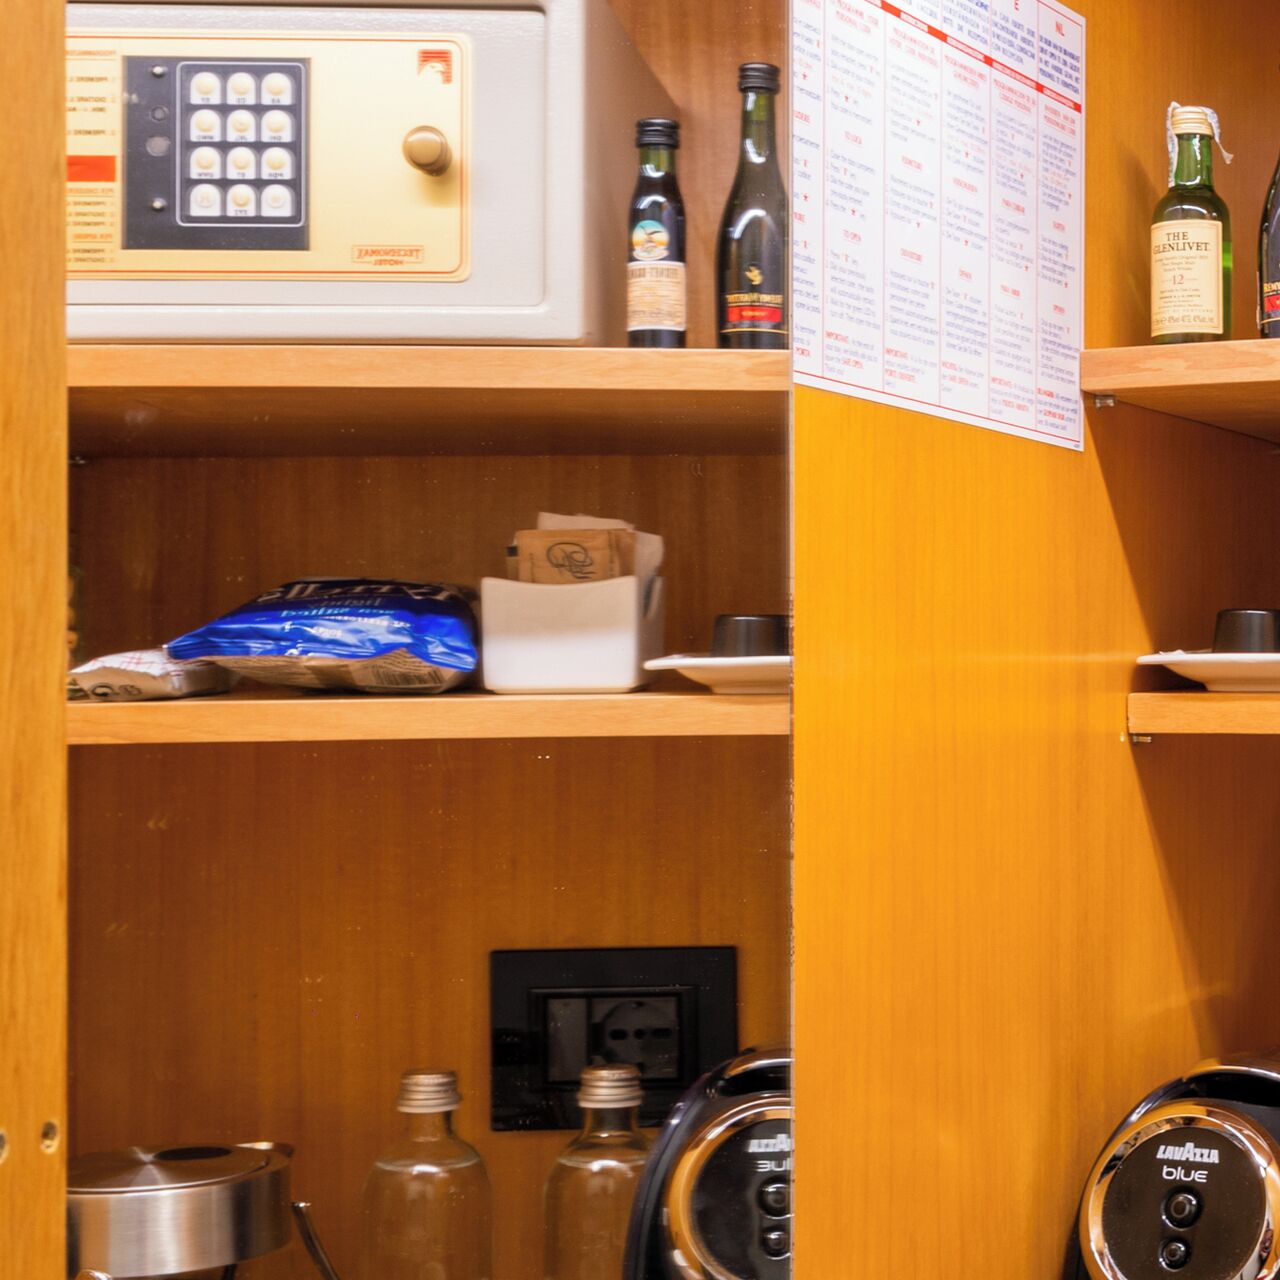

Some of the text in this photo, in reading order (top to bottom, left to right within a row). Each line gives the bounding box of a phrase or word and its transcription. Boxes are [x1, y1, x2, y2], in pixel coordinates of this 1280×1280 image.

[1166, 231, 1189, 242] THE
[1153, 241, 1211, 255] GLENLIVET
[1172, 274, 1184, 285] 12
[1156, 1141, 1219, 1164] LAVAZZA
